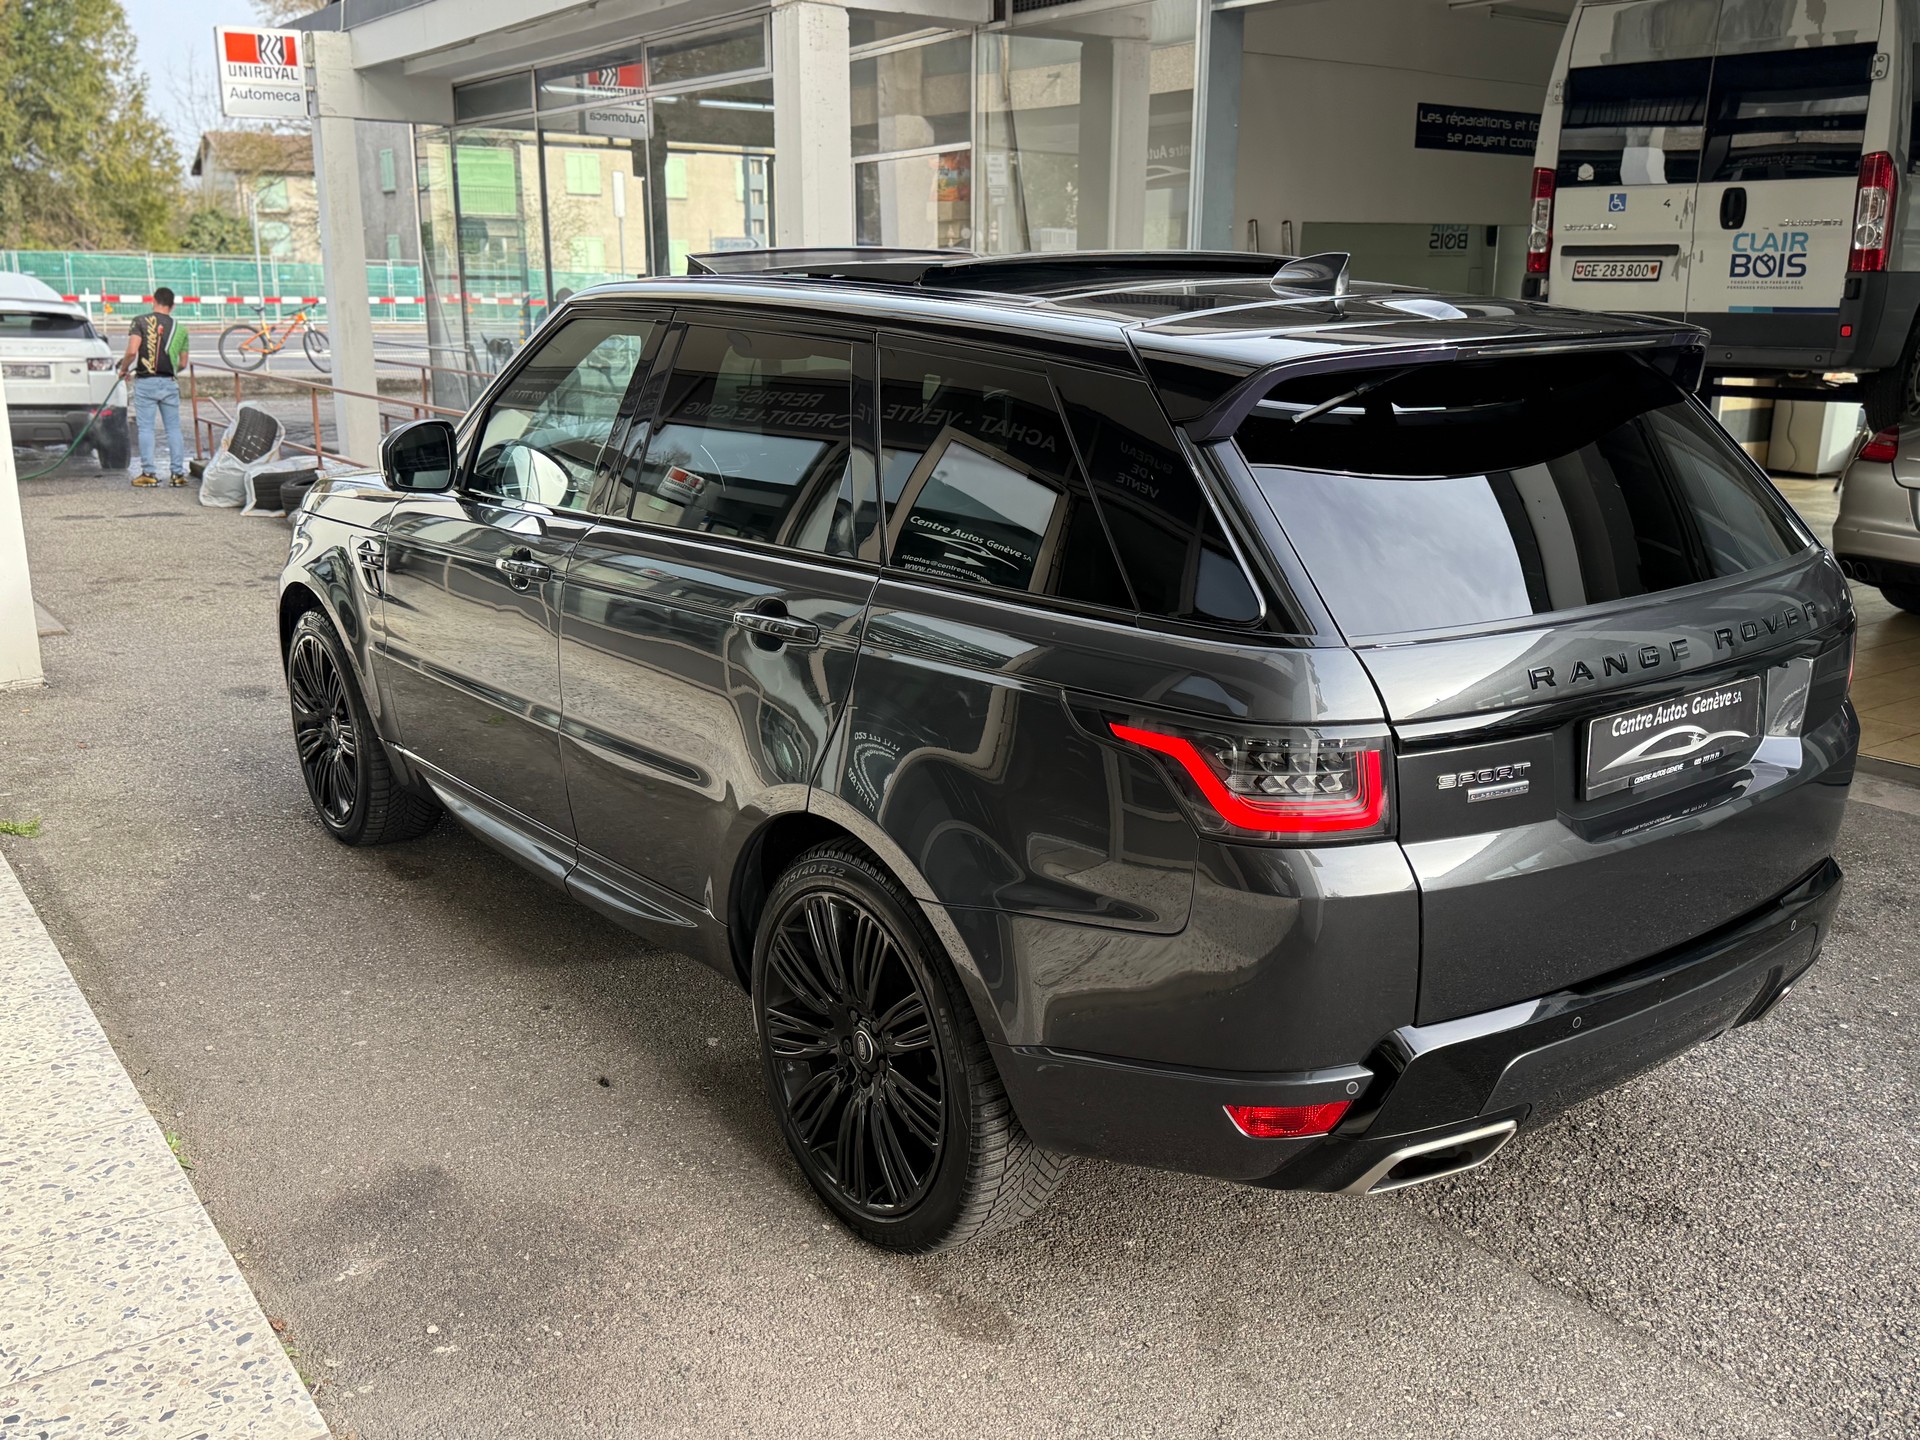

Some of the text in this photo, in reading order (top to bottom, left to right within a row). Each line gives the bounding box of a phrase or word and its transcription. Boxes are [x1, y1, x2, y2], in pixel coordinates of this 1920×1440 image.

[228, 64, 299, 80] UNIROYAL
[230, 86, 301, 102] Automeca
[1420, 110, 1442, 124] Les
[1445, 111, 1512, 130] réparations
[1514, 120, 1527, 130] et
[1447, 133, 1463, 143] se
[1465, 134, 1507, 148] payent
[1663, 199, 1671, 208] 4
[1732, 232, 1809, 252] CLAIR
[1729, 253, 1807, 278] BOIS
[910, 515, 1032, 562] Centre Autos Genève SA
[1527, 601, 1817, 690] RANGE ROVER
[1612, 691, 1743, 737] Centre Autos Genève SA
[1437, 762, 1531, 789] SPORT
[819, 864, 846, 877] R22
